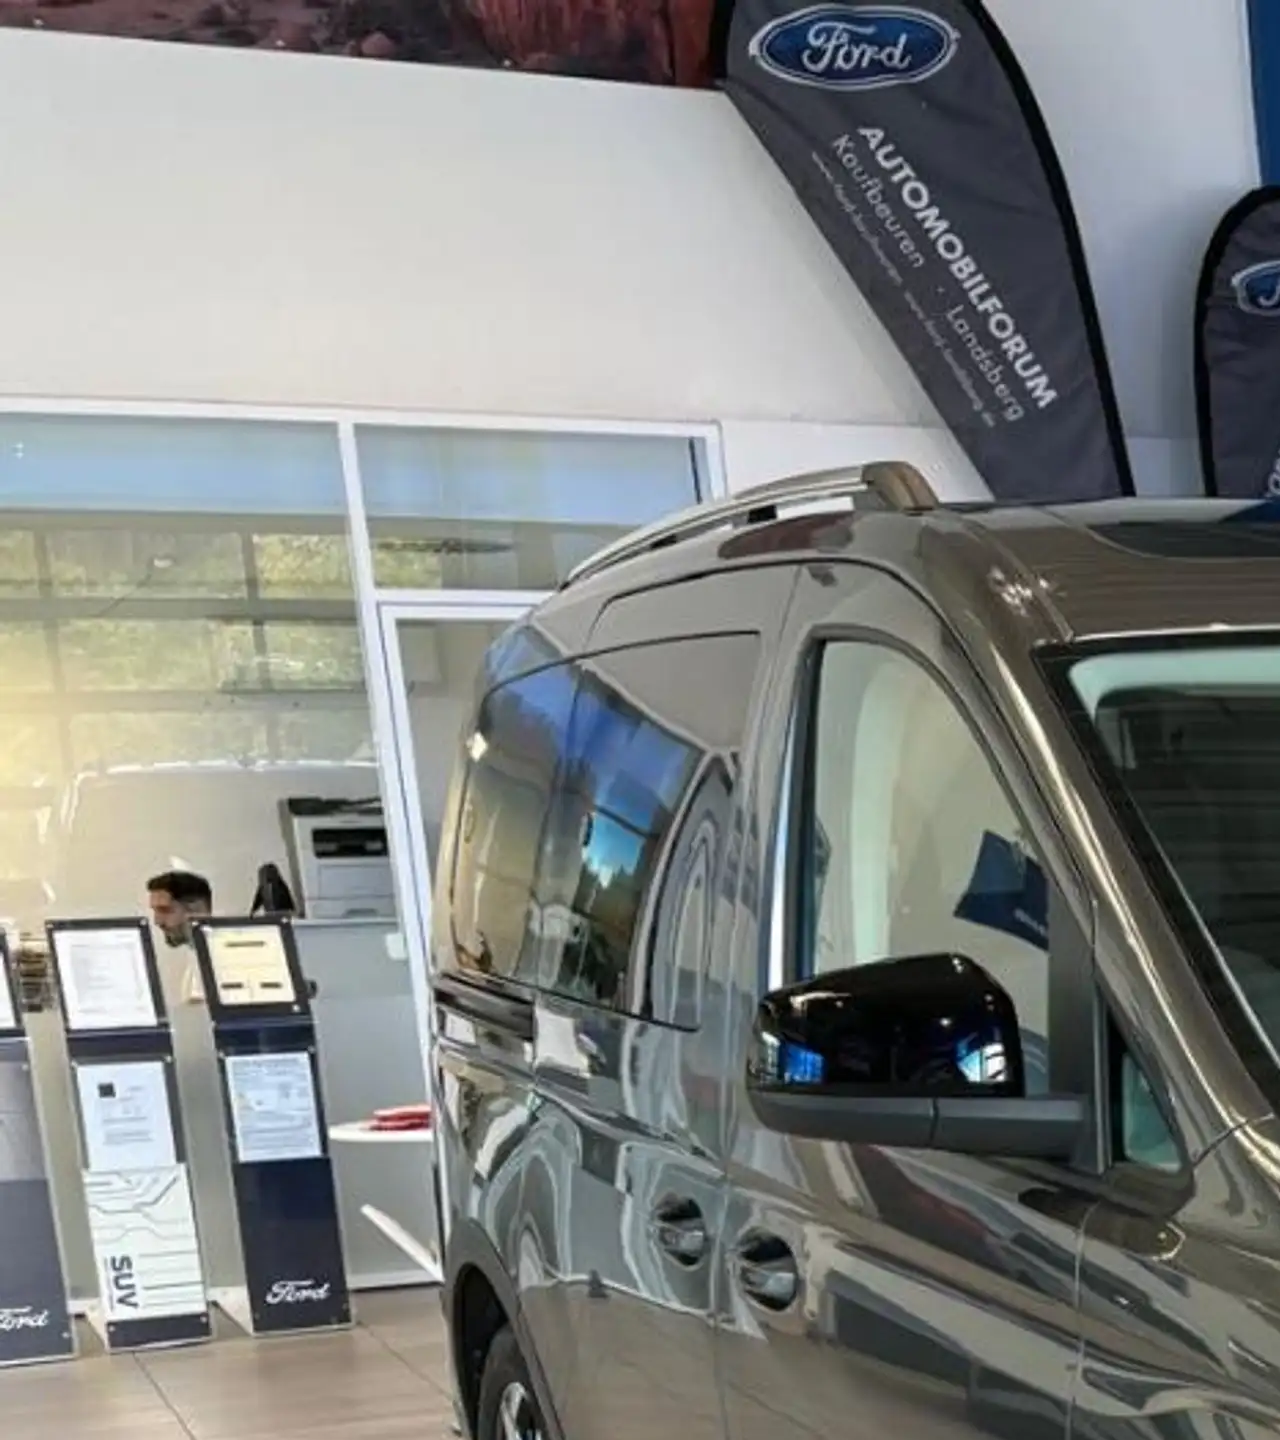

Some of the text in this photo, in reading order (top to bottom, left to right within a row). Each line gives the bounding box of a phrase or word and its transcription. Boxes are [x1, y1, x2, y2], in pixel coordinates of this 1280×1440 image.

[802, 21, 912, 73] Ford
[857, 127, 1058, 410] AUTOMOBILFORUM
[110, 1254, 139, 1309] SUV
[265, 1279, 332, 1305] Ford
